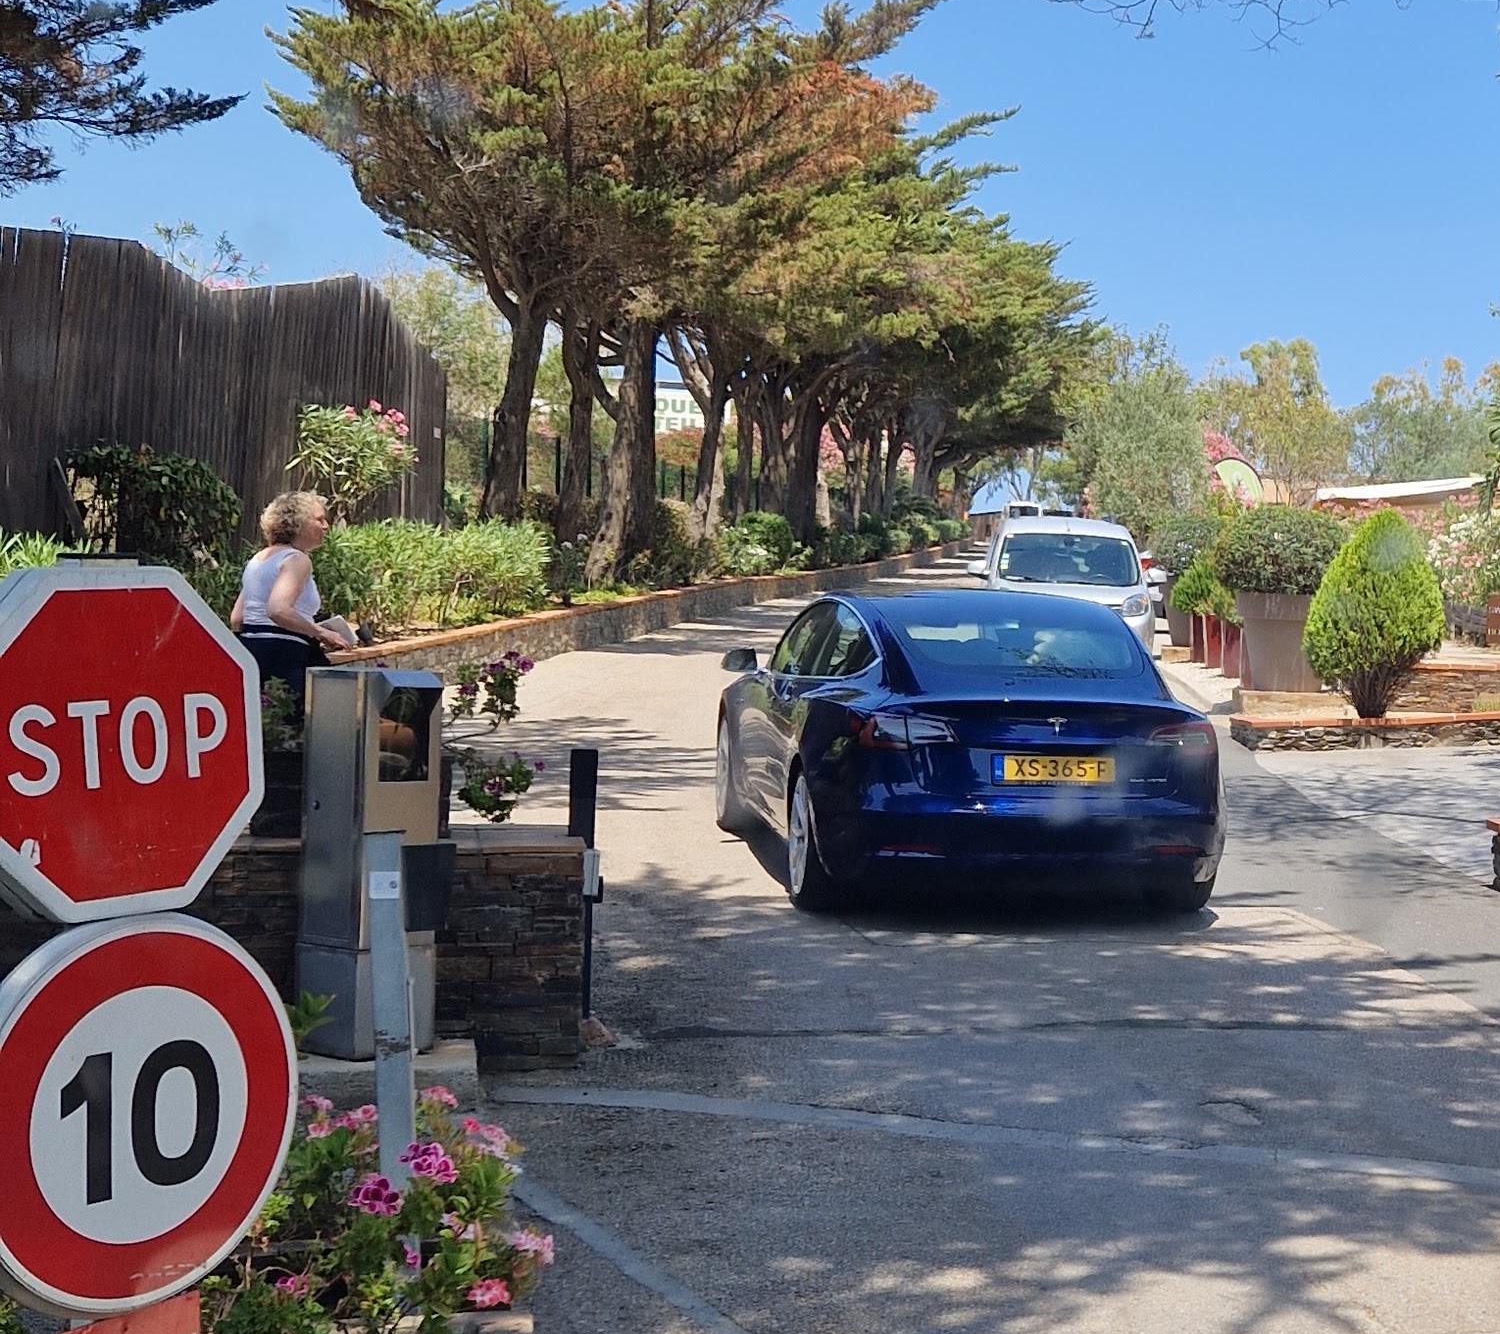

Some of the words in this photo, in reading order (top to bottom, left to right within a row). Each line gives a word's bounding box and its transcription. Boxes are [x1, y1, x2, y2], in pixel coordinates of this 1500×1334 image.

[8, 692, 228, 797] STOP
[1014, 758, 1106, 778] XS-365-F
[60, 1039, 220, 1205] 10
